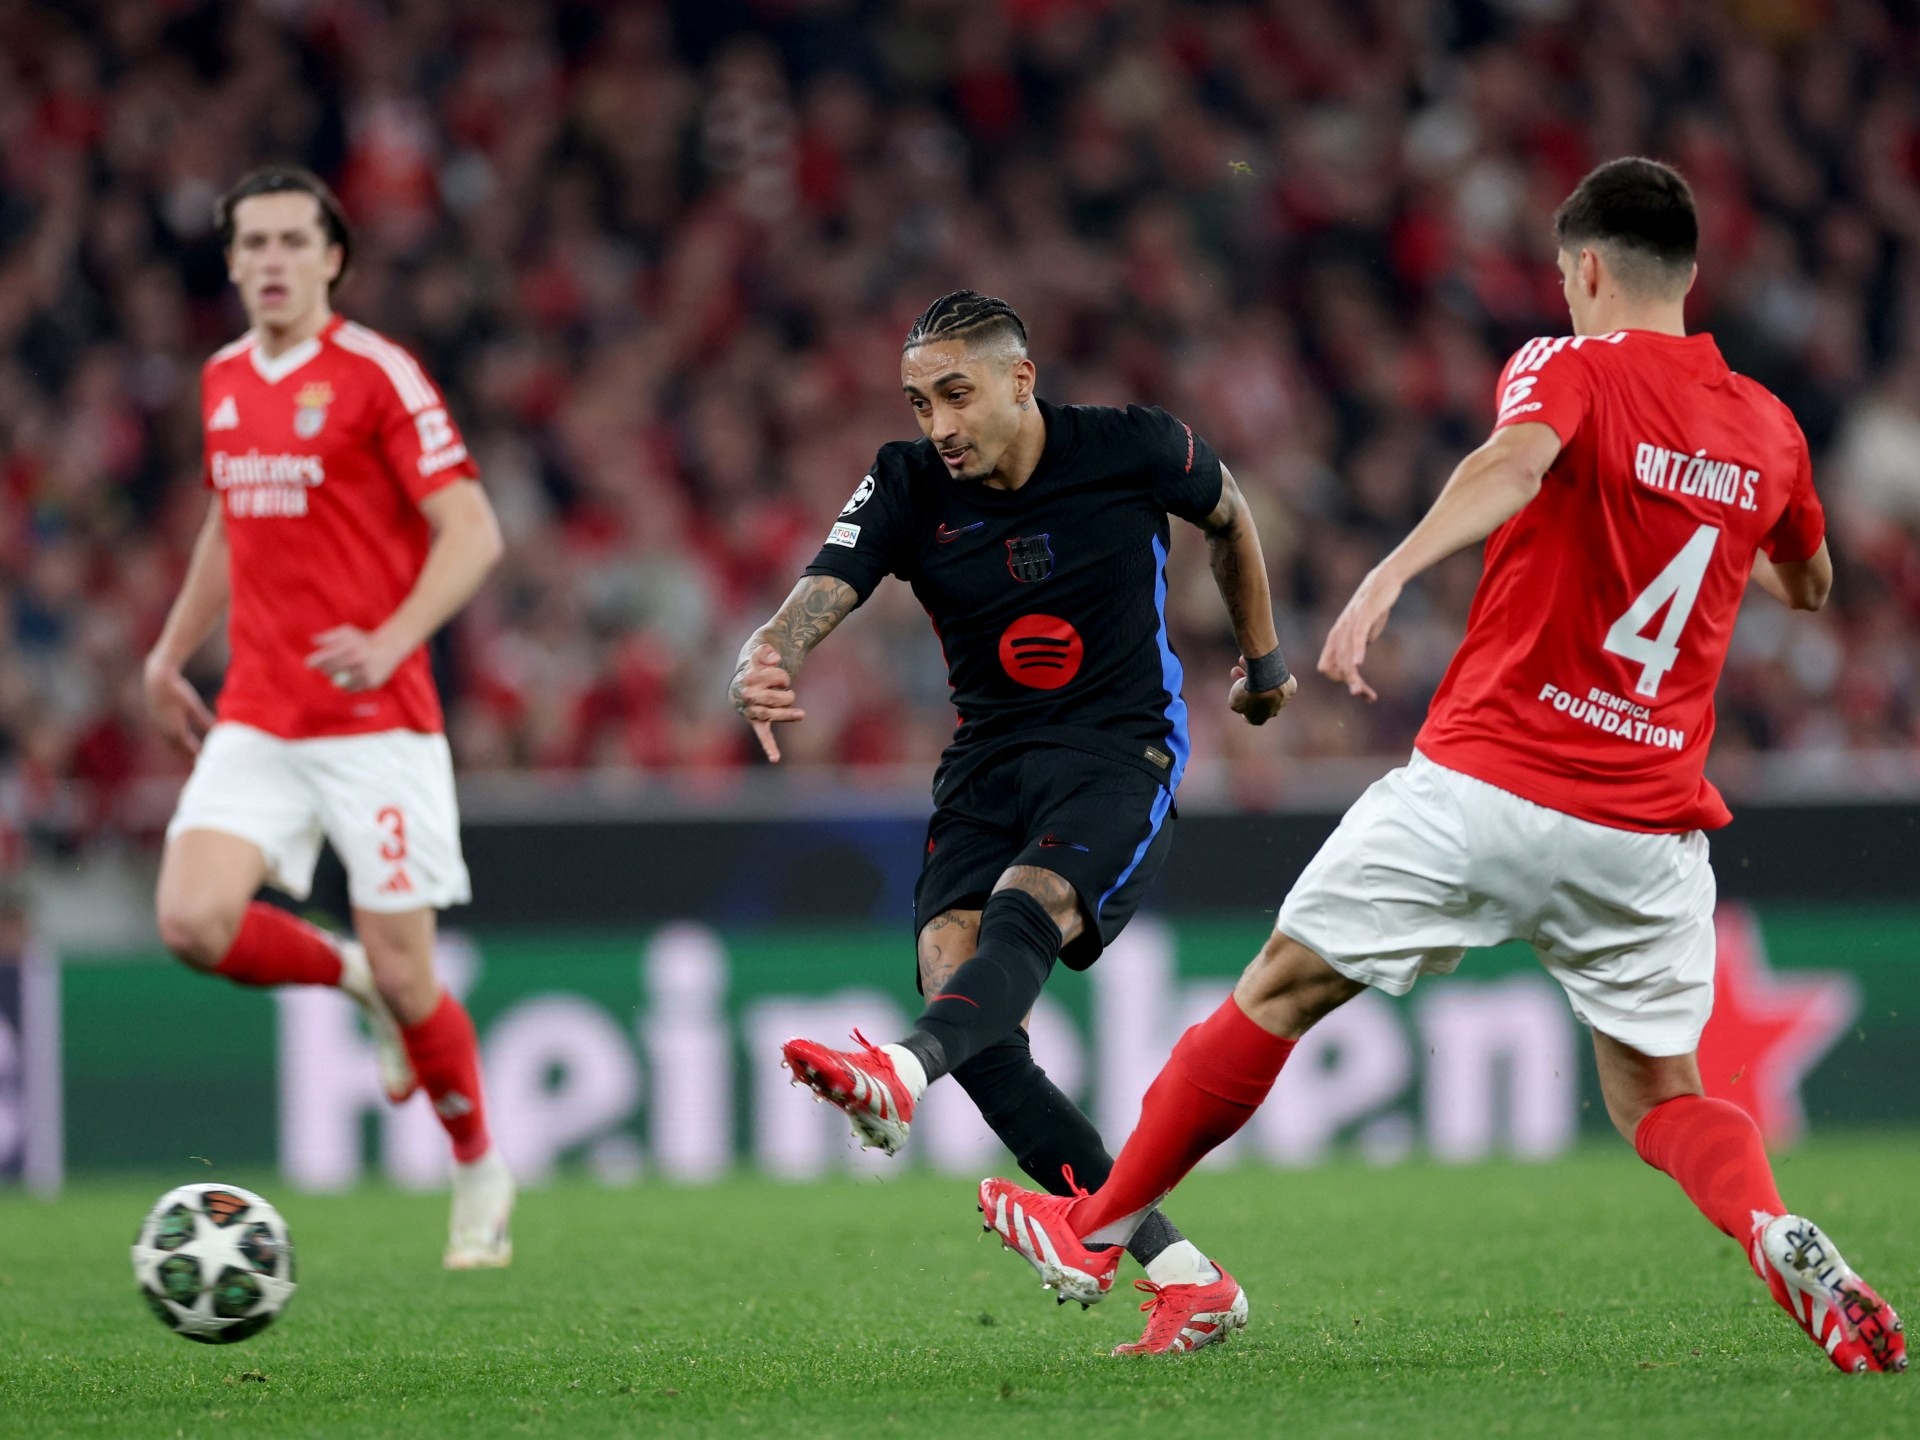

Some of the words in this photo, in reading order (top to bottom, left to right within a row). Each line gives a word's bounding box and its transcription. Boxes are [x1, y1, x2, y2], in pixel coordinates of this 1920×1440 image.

[211, 448, 325, 491] Emirates
[1634, 441, 1741, 505] ANTÓNIO
[1739, 469, 1760, 511] S.
[1602, 523, 1721, 698] 4
[1538, 682, 1685, 751] FOUNDATION
[1587, 681, 1651, 721] BENFICA
[375, 804, 407, 863] 3
[1785, 1222, 1902, 1372] REDATOR
